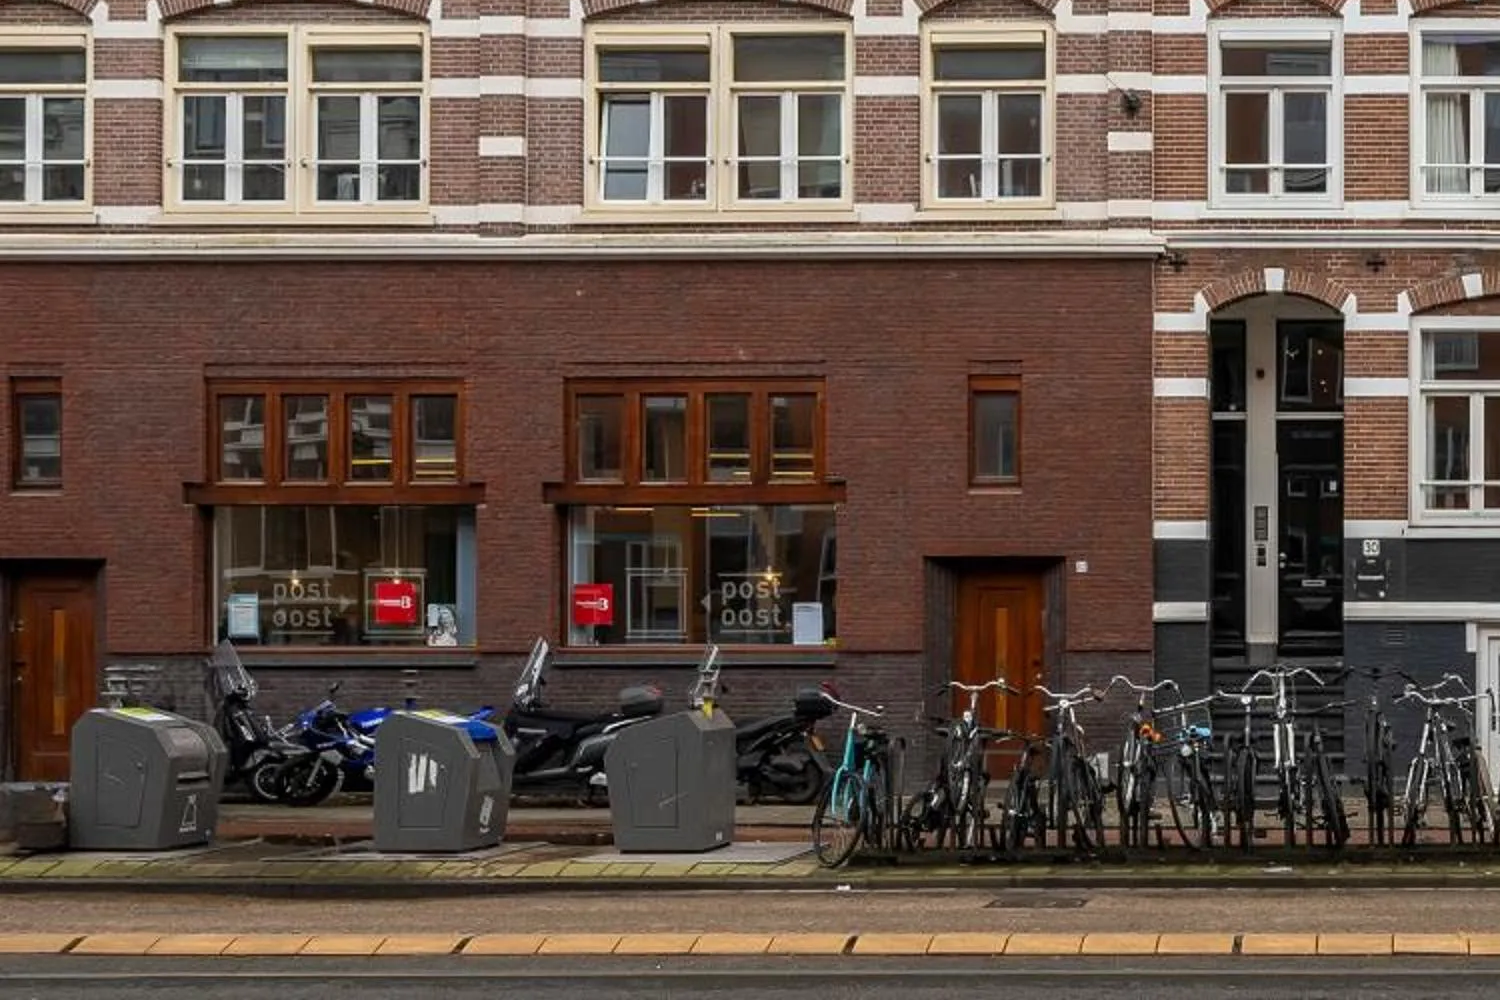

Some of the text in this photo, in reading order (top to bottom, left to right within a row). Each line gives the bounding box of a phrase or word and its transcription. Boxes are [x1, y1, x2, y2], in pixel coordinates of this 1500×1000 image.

[273, 579, 331, 605] post
[721, 578, 781, 605] post
[273, 606, 332, 627] oost
[721, 605, 781, 627] oost
